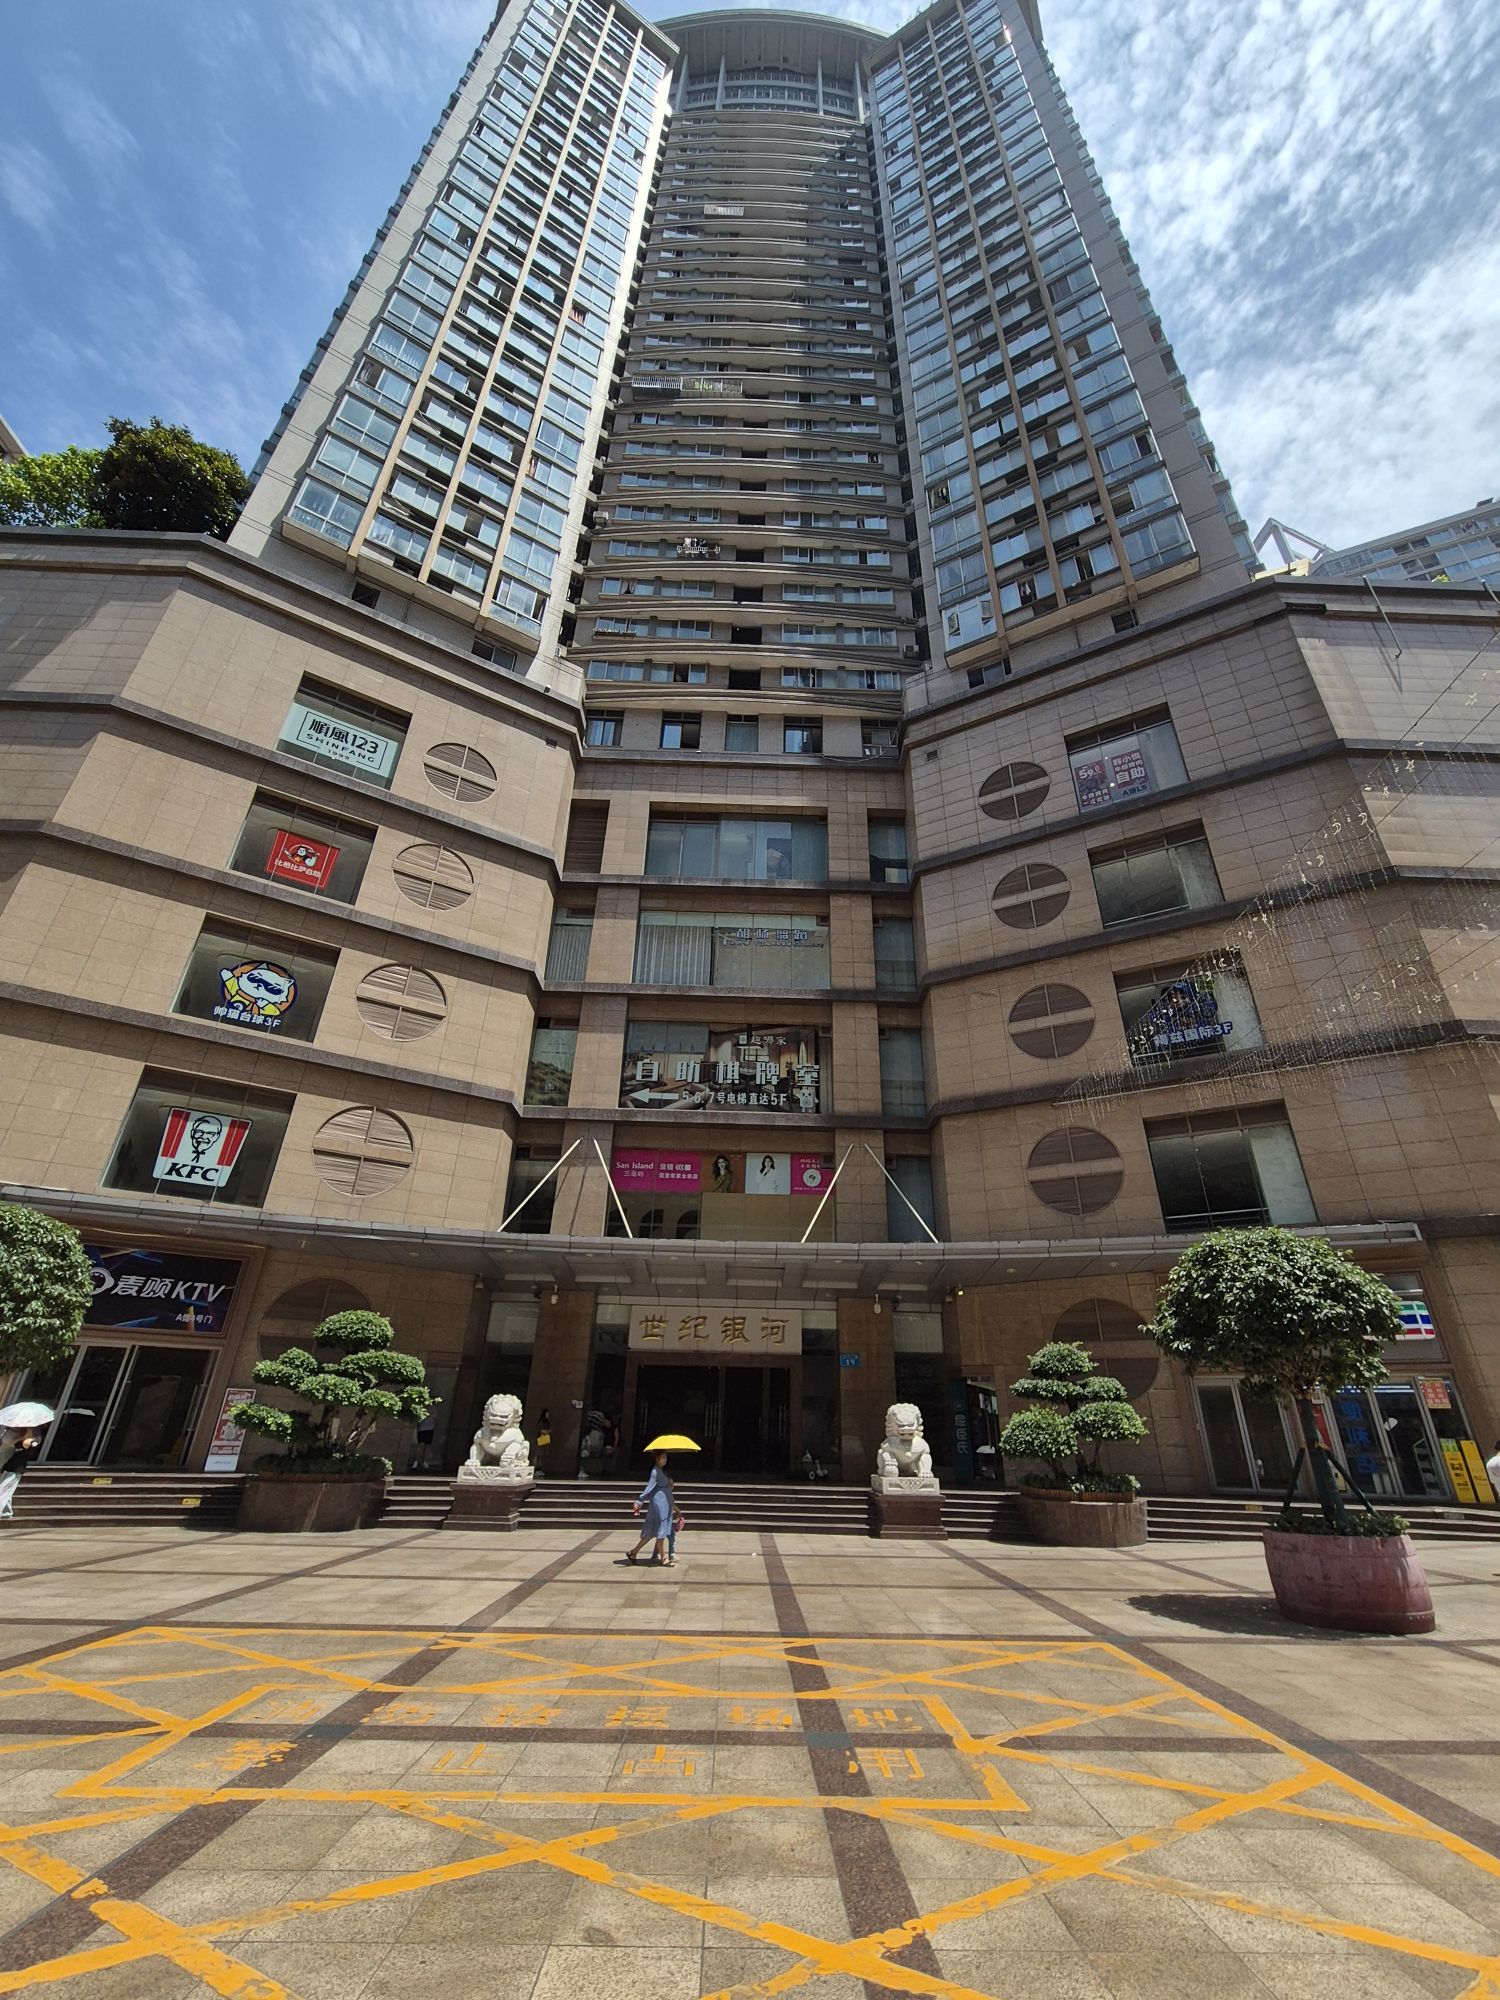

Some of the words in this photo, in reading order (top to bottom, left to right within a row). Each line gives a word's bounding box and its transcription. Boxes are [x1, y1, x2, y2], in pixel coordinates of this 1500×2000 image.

[306, 733, 375, 763] SHINFANG
[309, 719, 379, 754] 順風123
[1116, 767, 1146, 784] 自助
[164, 1162, 219, 1182] KFC
[632, 1162, 654, 1170] Island
[111, 1275, 226, 1302] 麦颂KTV
[639, 1313, 790, 1345] 世纪银河
